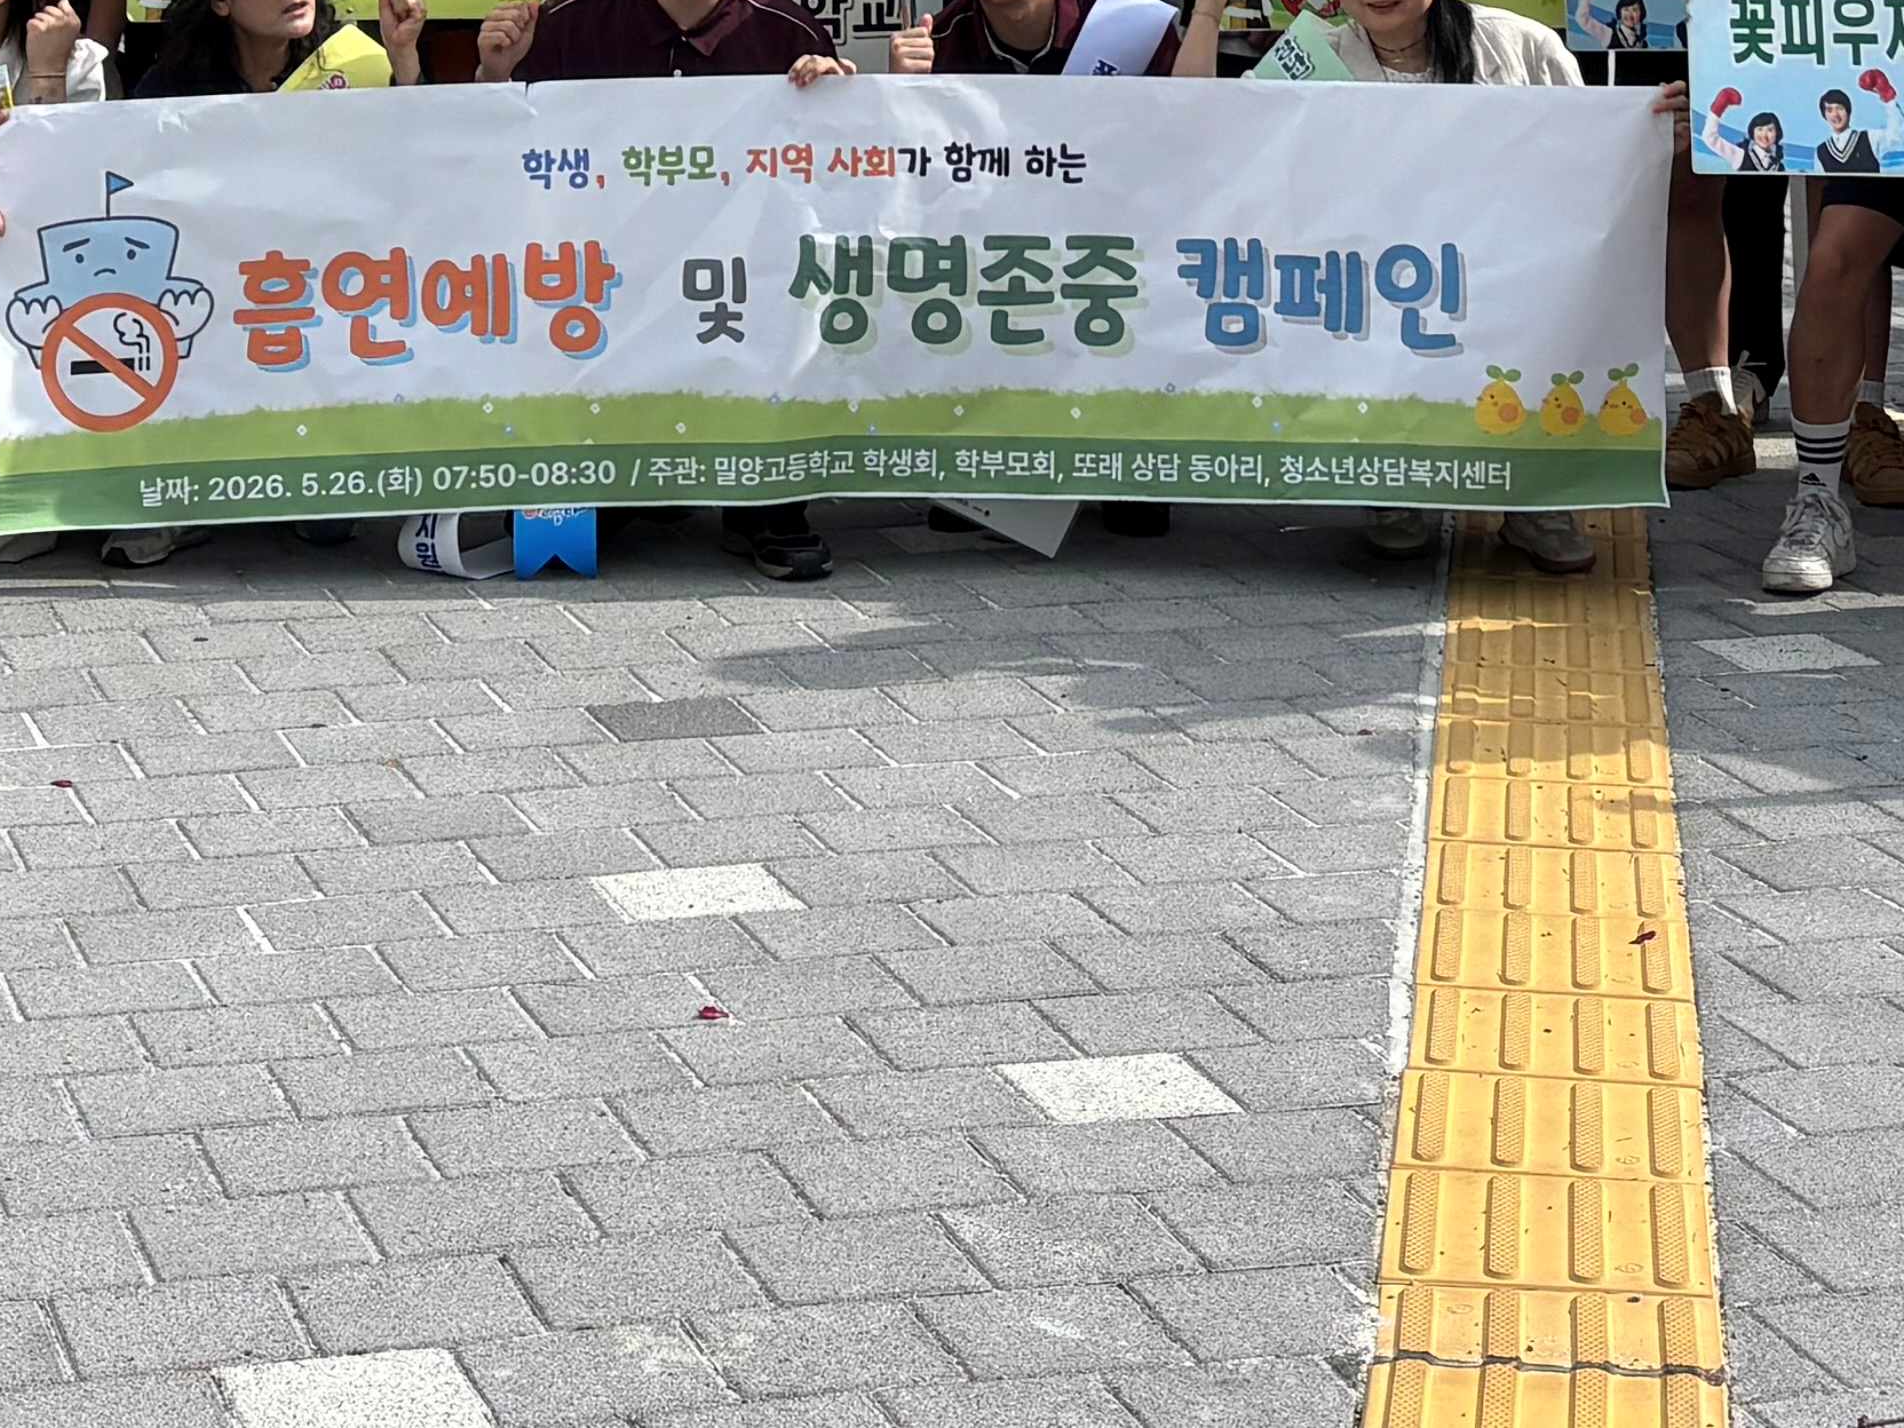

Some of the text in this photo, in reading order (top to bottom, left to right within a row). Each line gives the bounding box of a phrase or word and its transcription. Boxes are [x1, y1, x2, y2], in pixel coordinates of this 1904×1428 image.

[521, 142, 1087, 190] 학생, 학부모, 지역 사회가 함께 하는
[233, 234, 1462, 370] 흡연예방 및 생명존중 캠페인
[139, 477, 201, 508] 날짜:
[208, 473, 293, 501] 2026.
[301, 466, 424, 498] 5.26.(화)
[434, 460, 617, 492] 07:50-08:30
[648, 457, 705, 488] 주관:
[713, 451, 856, 485] 밀양고등학교
[862, 447, 946, 482] 학생회,
[955, 447, 1064, 483] 학부모회,
[1072, 450, 1124, 482] 또래
[1131, 450, 1182, 484] 상담
[1189, 451, 1271, 487] 동아리,
[1279, 453, 1513, 491] 청소년상담복지센터
